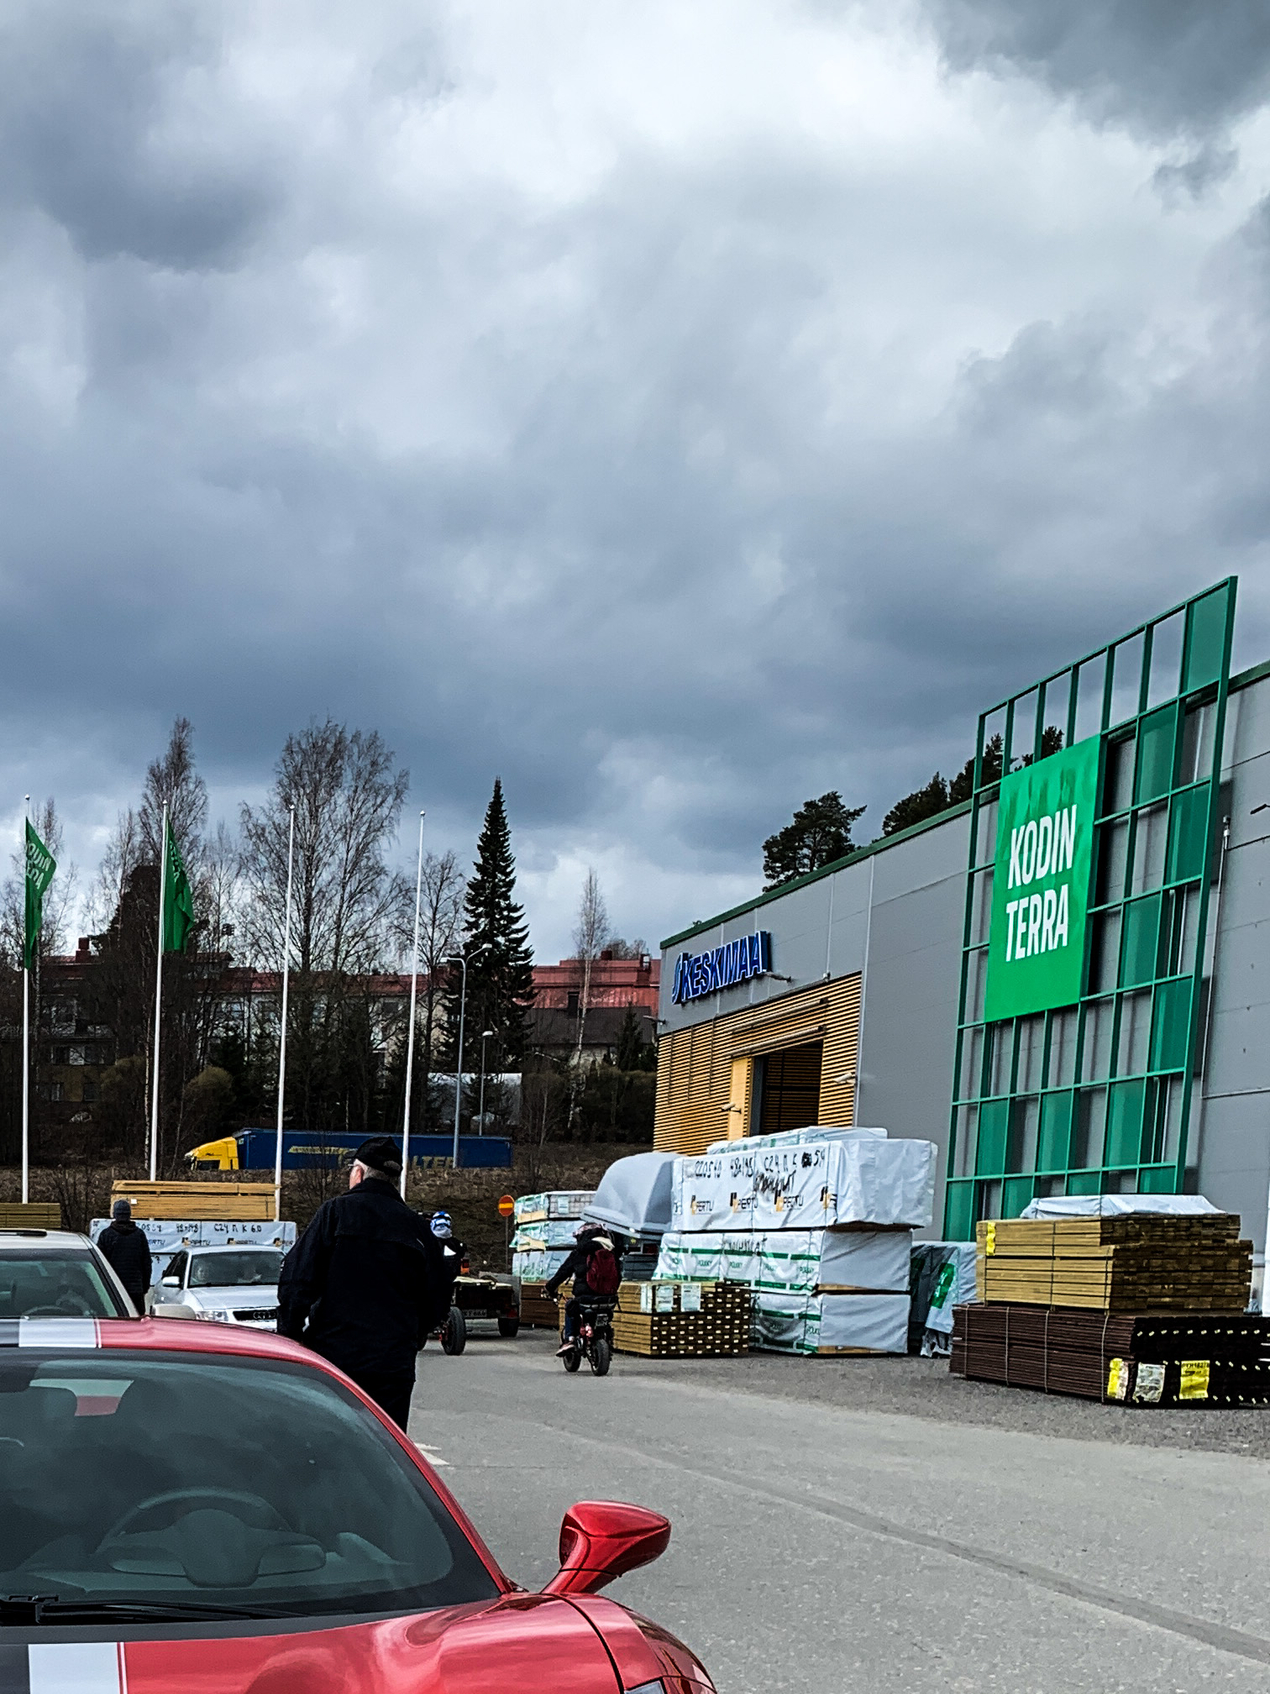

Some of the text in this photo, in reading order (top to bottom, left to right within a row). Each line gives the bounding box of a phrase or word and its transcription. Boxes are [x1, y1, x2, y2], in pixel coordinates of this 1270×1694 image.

[1007, 803, 1077, 889] KODIN
[1005, 883, 1069, 963] TERRA
[681, 931, 766, 1002] KESKIMAA
